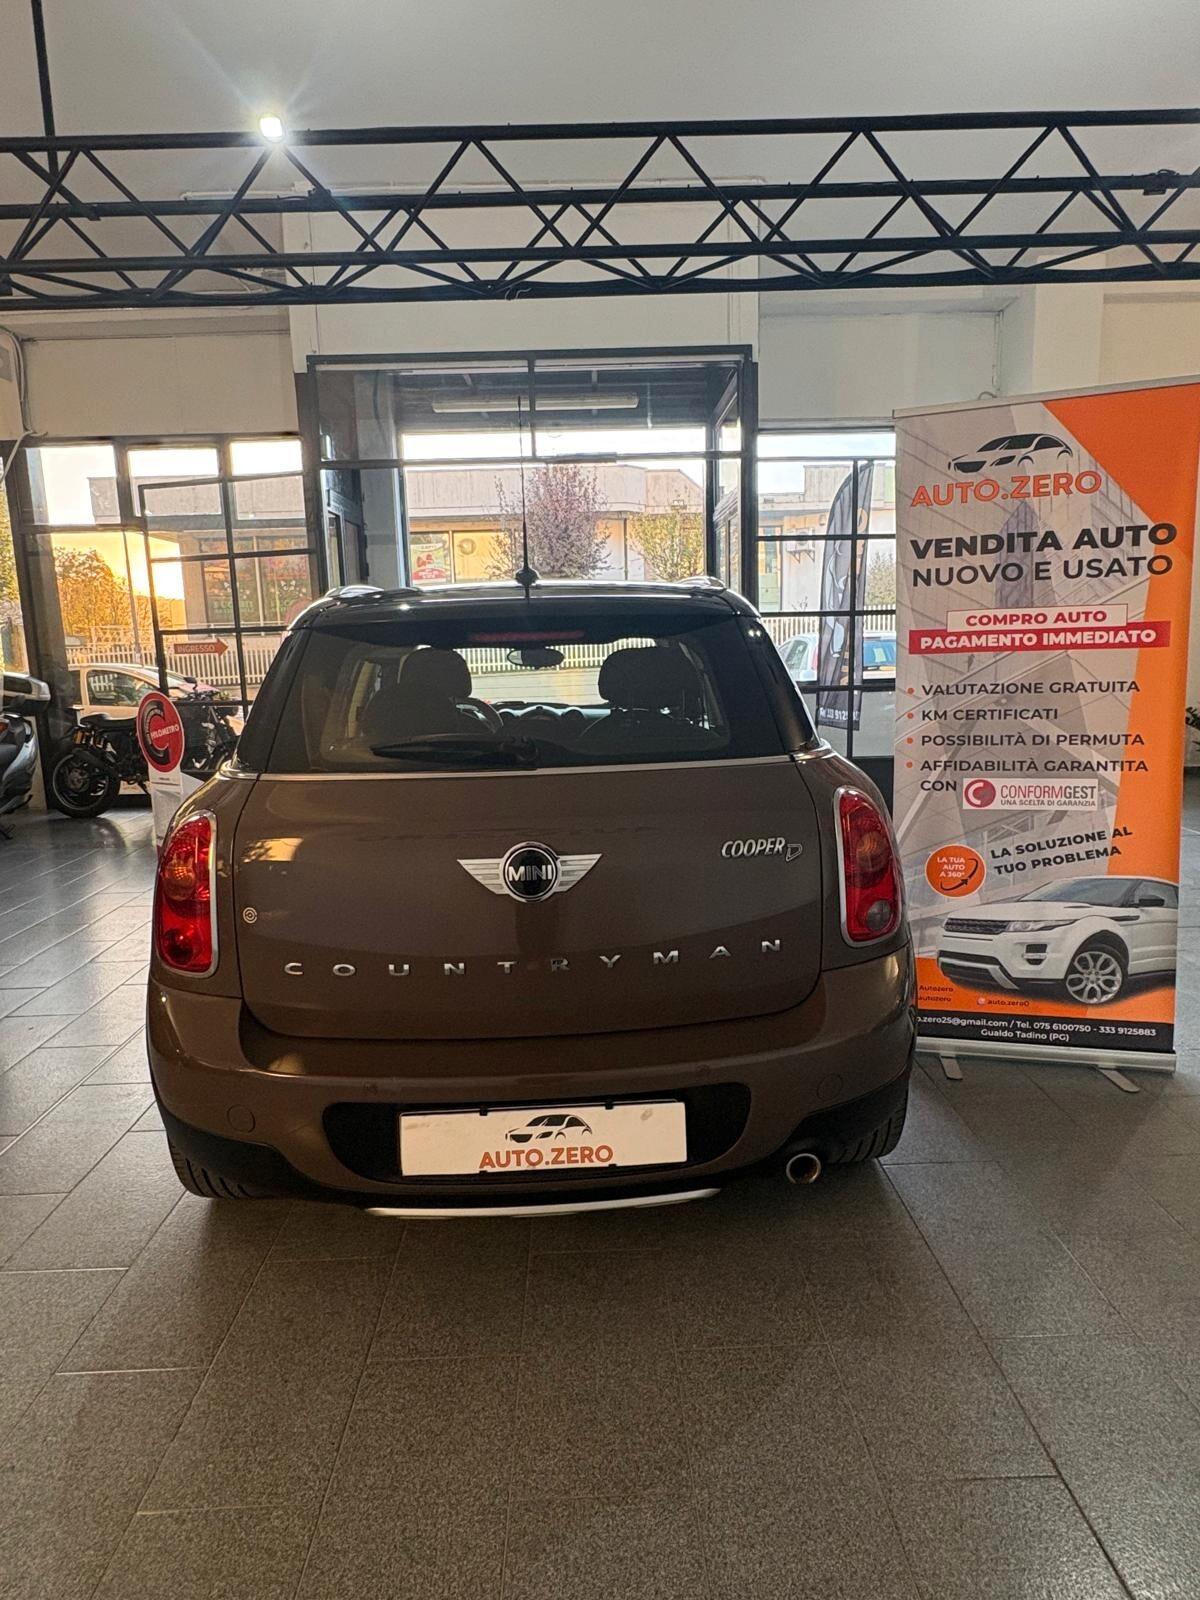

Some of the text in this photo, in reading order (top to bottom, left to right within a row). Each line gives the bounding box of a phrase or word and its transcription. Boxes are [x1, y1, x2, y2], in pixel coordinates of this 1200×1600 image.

[910, 470, 1102, 507] AUTO.ZERO
[910, 523, 1178, 560] VENDITA AUTO
[912, 555, 1173, 587] NUOVO E USATO
[965, 610, 1107, 627] COMPRO AUTO
[920, 629, 1157, 650] PAGAMENTO IMMEDIATO
[177, 644, 216, 653] INGRESSO
[921, 680, 1140, 696] VALUTAZIONE GRATUITA
[921, 708, 1058, 721] KM CERTIFICATI
[921, 732, 1145, 746] POSSIBILITÀ DI PERMUTA
[920, 757, 1149, 772] AFFIDABILITÀ GARANTITA
[920, 780, 957, 792] CON
[1000, 785, 1097, 799] CONFORMGEST
[721, 837, 803, 862] COOPER D
[990, 826, 1133, 860] LA SOLUZIONE AL
[994, 846, 1122, 876] TUO PROBLEMA
[508, 864, 552, 881] MINI
[284, 939, 781, 976] COUNTRYMAN
[919, 985, 954, 993] Autozero
[980, 1028, 1070, 1042] Gualdo Tadino (PG)
[1016, 1021, 1031, 1029] Tel.
[1033, 1022, 1050, 1030] 075
[1052, 1023, 1091, 1032] 6100750
[1099, 1026, 1116, 1034] 333
[1117, 1027, 1157, 1036] 9125883
[479, 1144, 614, 1169] AUTO.ZERO
